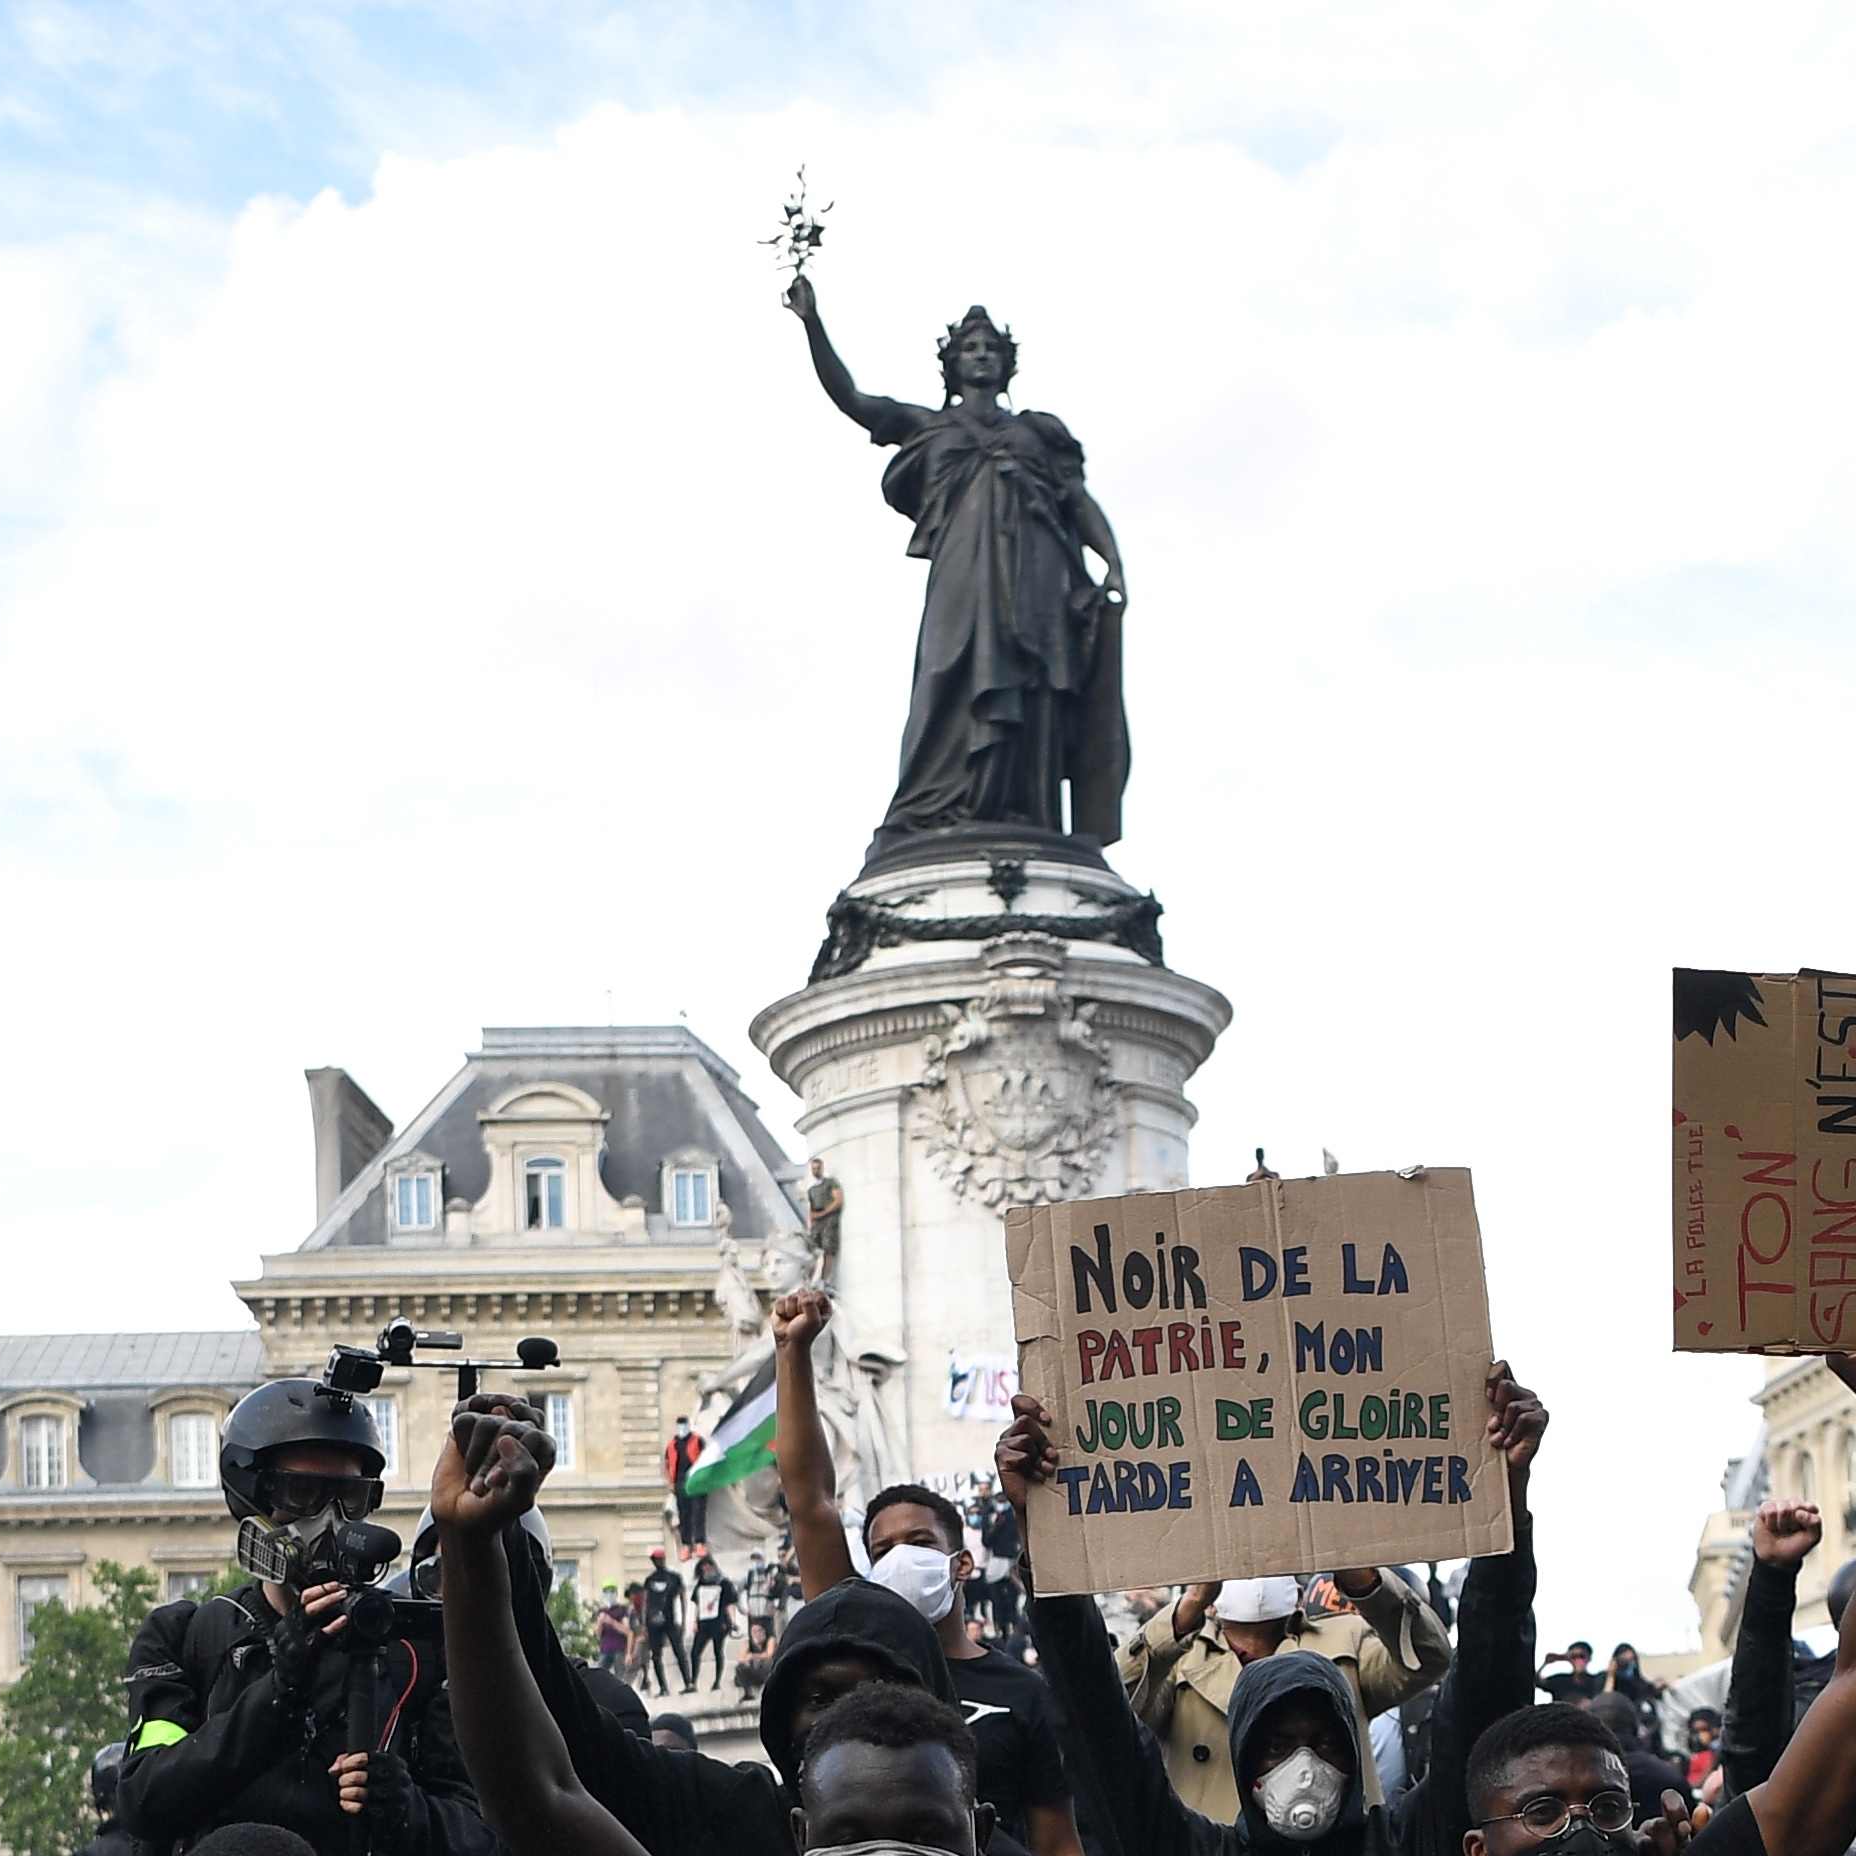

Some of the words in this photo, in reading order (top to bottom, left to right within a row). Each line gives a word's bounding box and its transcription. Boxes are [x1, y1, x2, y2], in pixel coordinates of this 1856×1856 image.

[1686, 1180, 1707, 1250] POLICE
[1737, 1150, 1797, 1332] TON
[1239, 1245, 1312, 1302] DE
[1341, 1242, 1409, 1295] LA
[1685, 1259, 1707, 1297] LA
[1295, 1319, 1384, 1375] MON
[1075, 1393, 1184, 1453] JOUR
[1215, 1396, 1275, 1441] DE
[1056, 1460, 1192, 1516] TARDE
[1228, 1457, 1264, 1508] A
